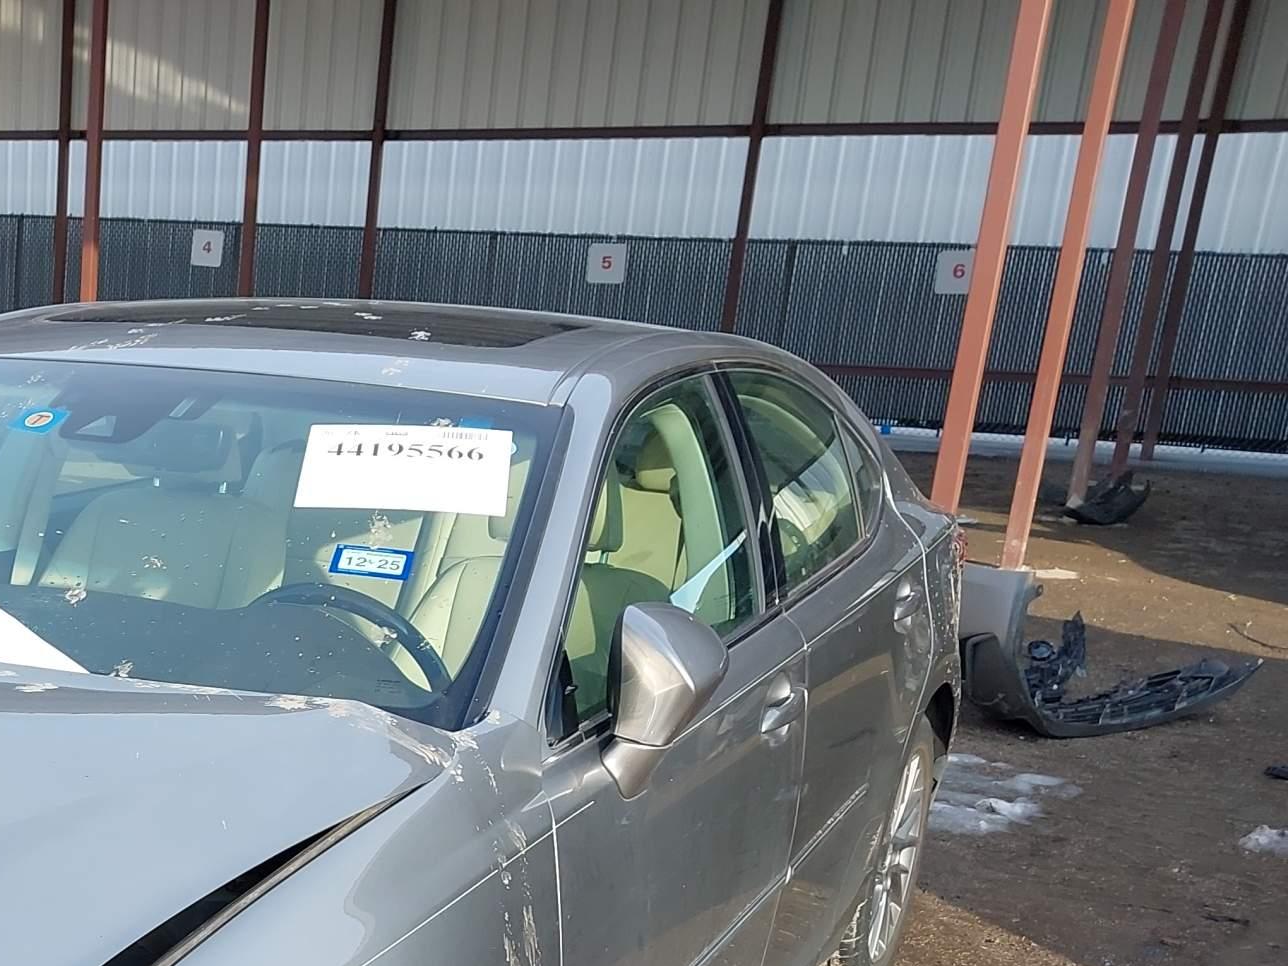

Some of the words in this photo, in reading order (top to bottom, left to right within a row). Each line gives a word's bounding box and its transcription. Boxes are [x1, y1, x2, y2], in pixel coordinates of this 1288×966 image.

[202, 240, 212, 254] 4
[601, 256, 612, 269] 5
[952, 263, 965, 279] 6
[327, 442, 484, 461] 44195566
[377, 558, 401, 571] 25
